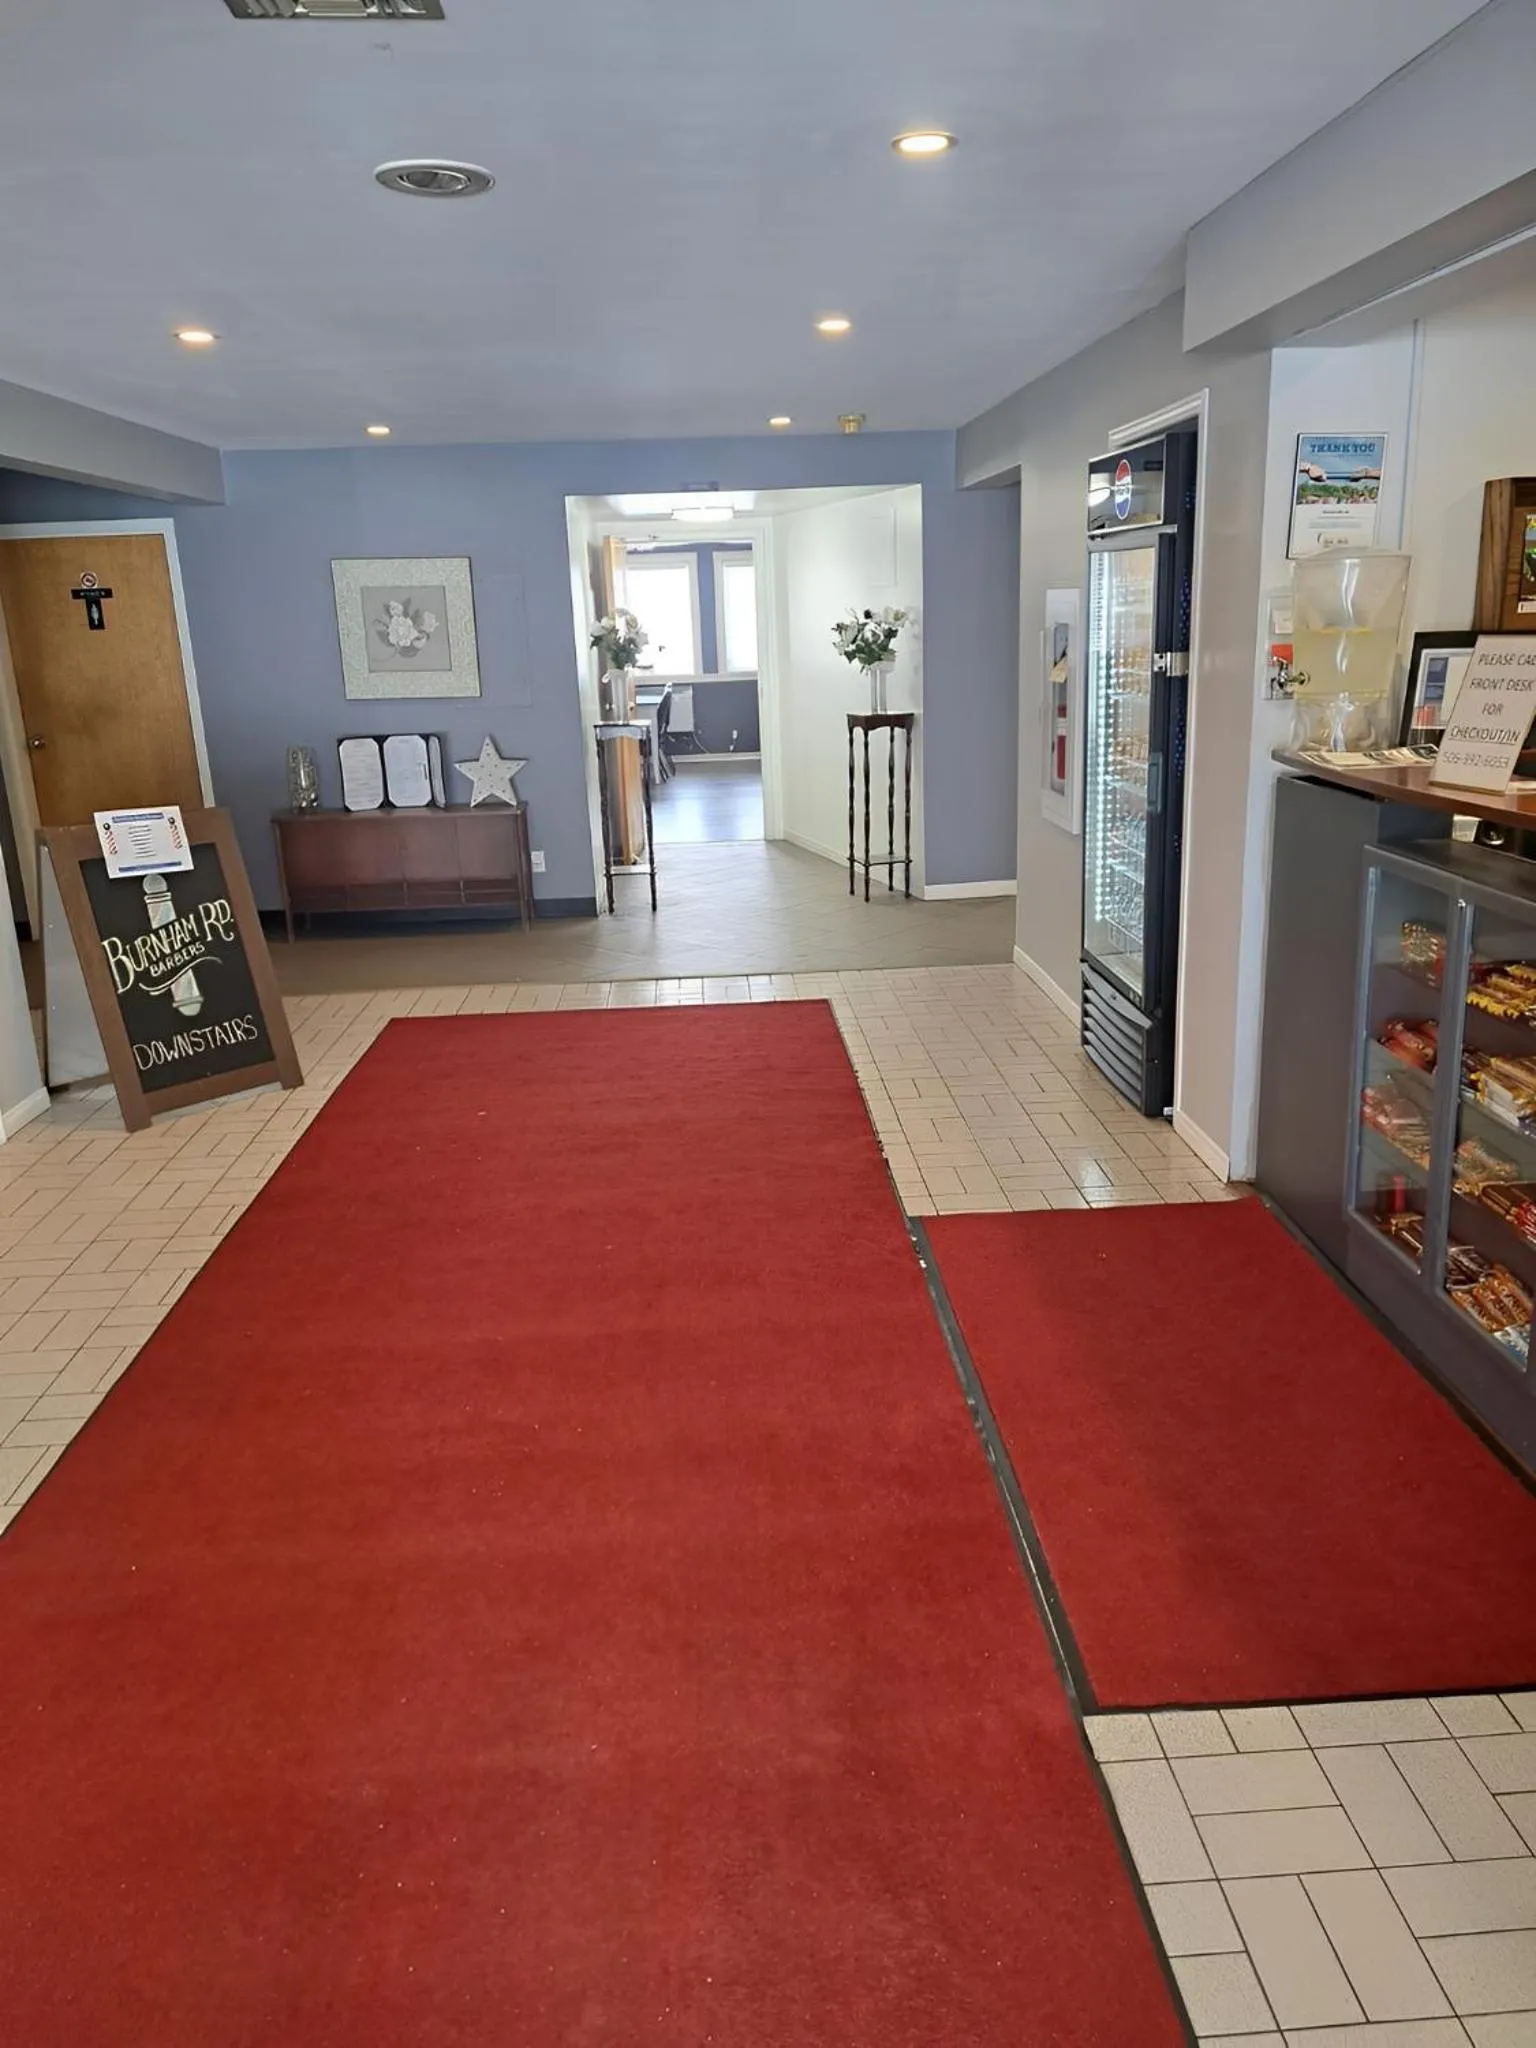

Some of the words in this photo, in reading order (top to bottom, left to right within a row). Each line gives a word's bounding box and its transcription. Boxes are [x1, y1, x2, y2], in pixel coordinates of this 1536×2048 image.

[1310, 443, 1350, 453] THANK
[1352, 442, 1376, 453] YOU
[1477, 653, 1514, 666] PLEASE
[1517, 654, 1536, 666] CAL
[1470, 678, 1505, 691] FRONT
[1506, 680, 1534, 692] DESK
[1482, 703, 1504, 716] FOR
[149, 942, 205, 977] BARBERS
[133, 1014, 258, 1071] DOWNSTAIRS
